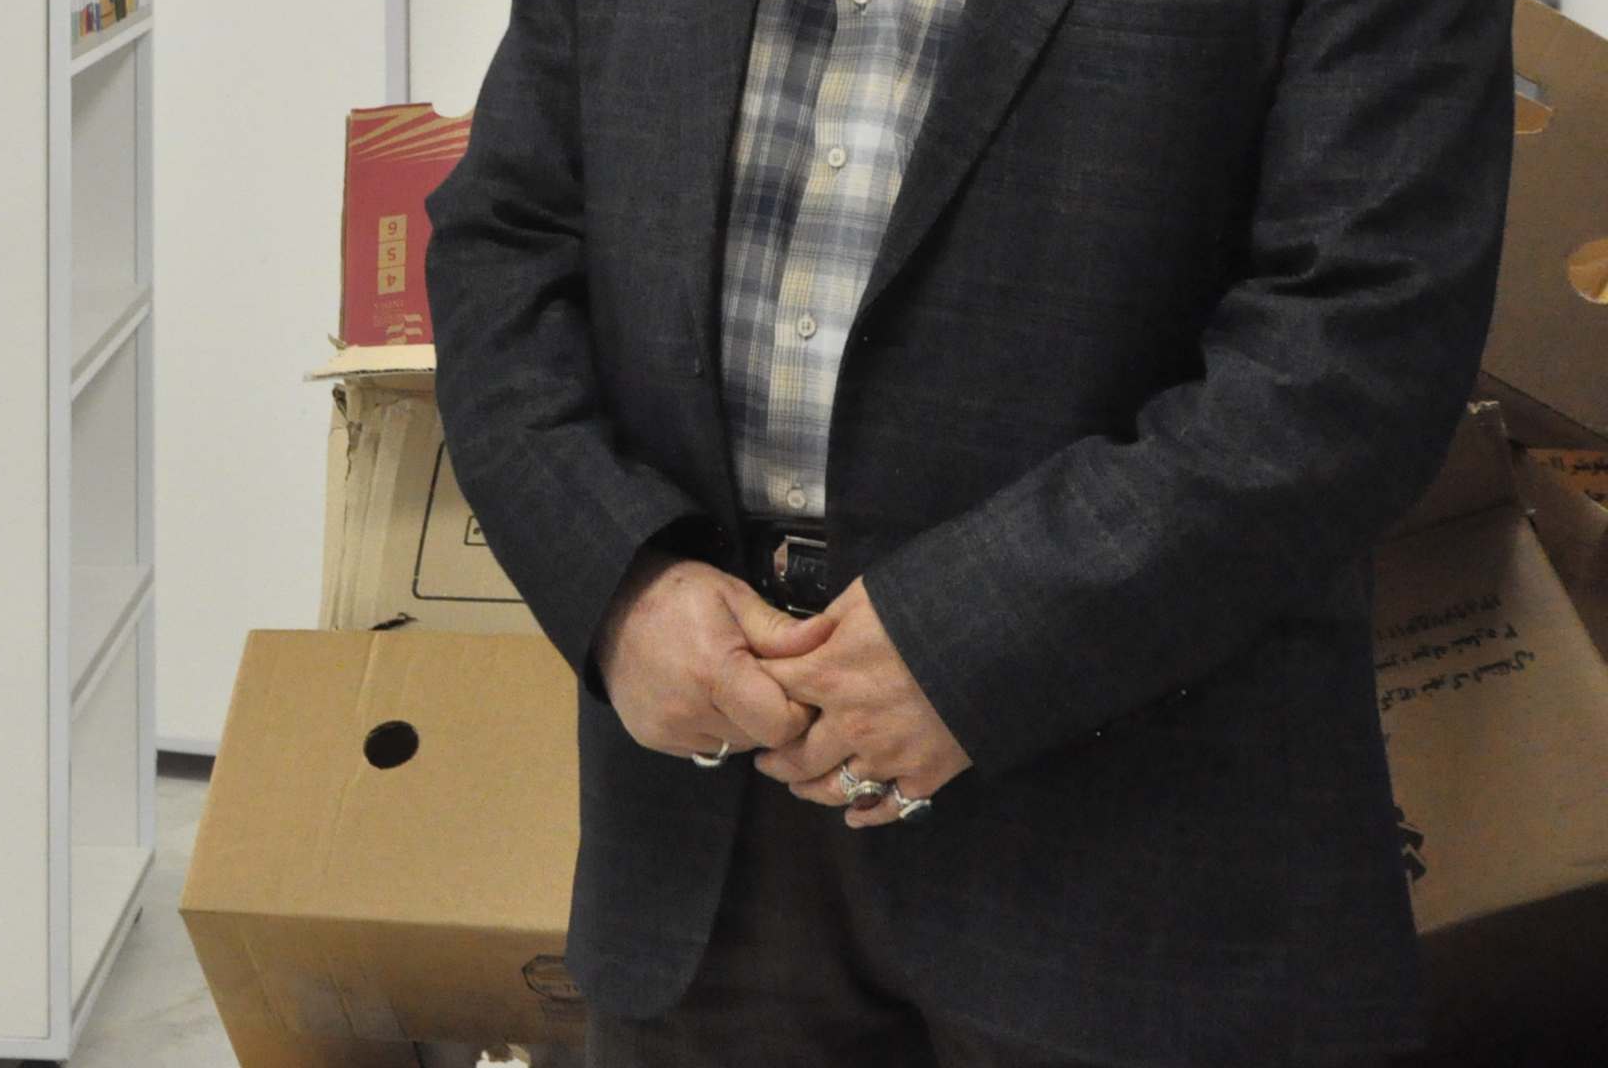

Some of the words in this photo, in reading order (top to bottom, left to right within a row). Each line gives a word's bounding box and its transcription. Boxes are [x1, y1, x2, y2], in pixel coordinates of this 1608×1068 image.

[388, 221, 398, 236] 6
[387, 247, 397, 261] 5
[385, 273, 396, 287] 4
